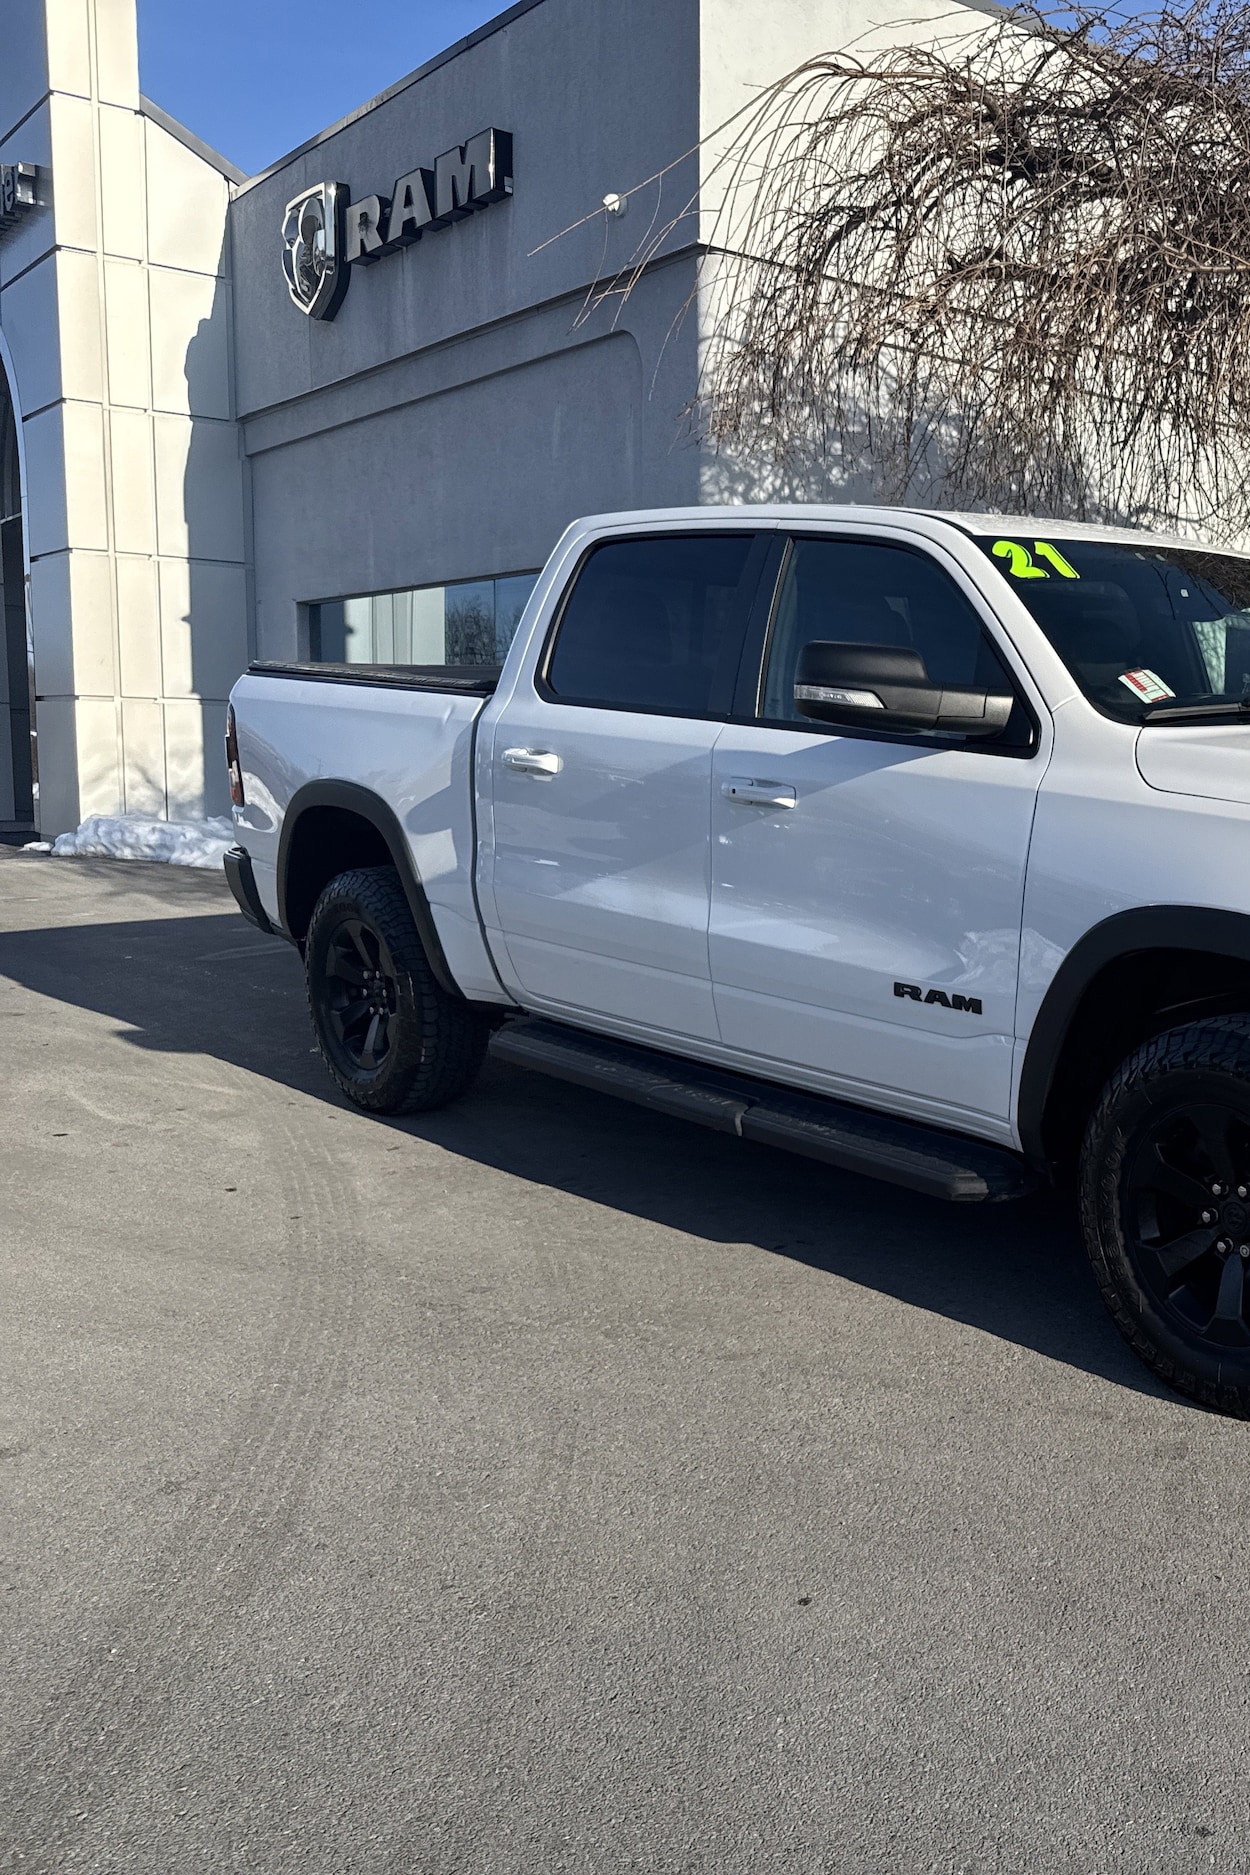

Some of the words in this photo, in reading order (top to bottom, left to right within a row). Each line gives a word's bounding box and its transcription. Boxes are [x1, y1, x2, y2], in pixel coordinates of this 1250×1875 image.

[345, 127, 513, 266] RAM
[991, 540, 1081, 579] 21
[894, 981, 983, 1015] RAM
